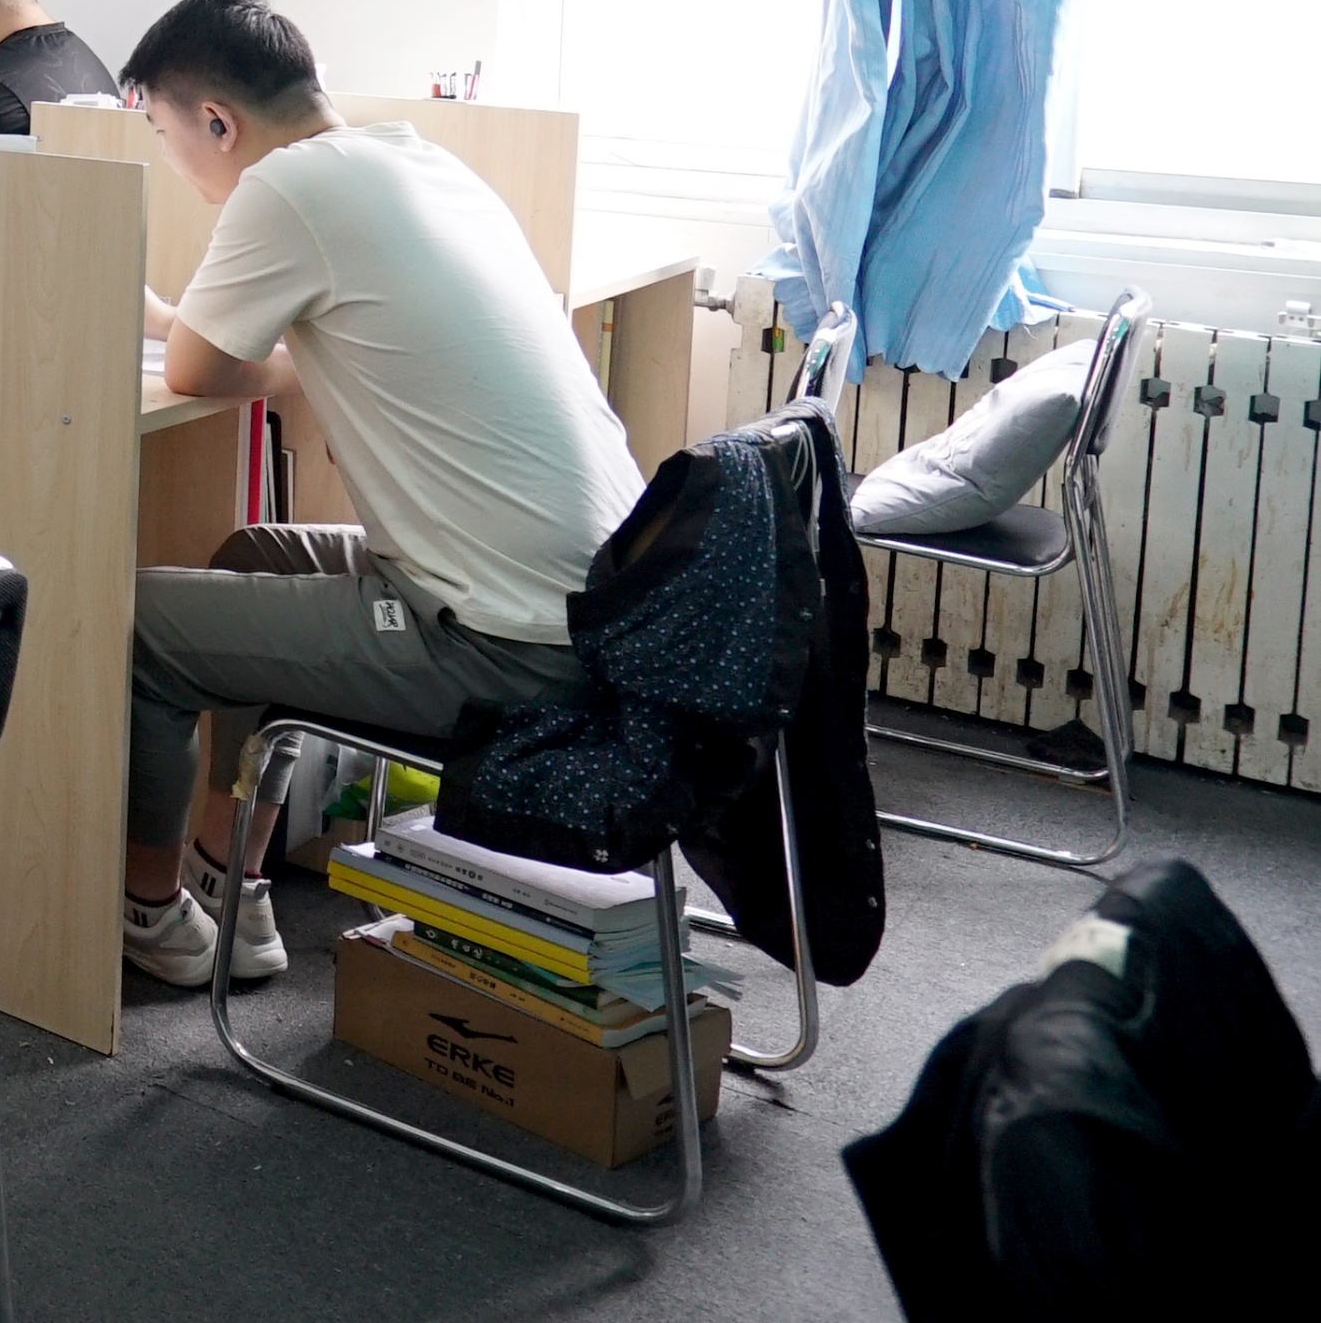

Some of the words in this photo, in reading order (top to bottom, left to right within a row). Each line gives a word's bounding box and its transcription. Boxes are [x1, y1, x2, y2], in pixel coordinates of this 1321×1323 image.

[424, 1056, 449, 1076] TO
[452, 1070, 477, 1091] BE
[481, 1084, 515, 1108] No.1
[426, 1033, 516, 1089] ERKE
